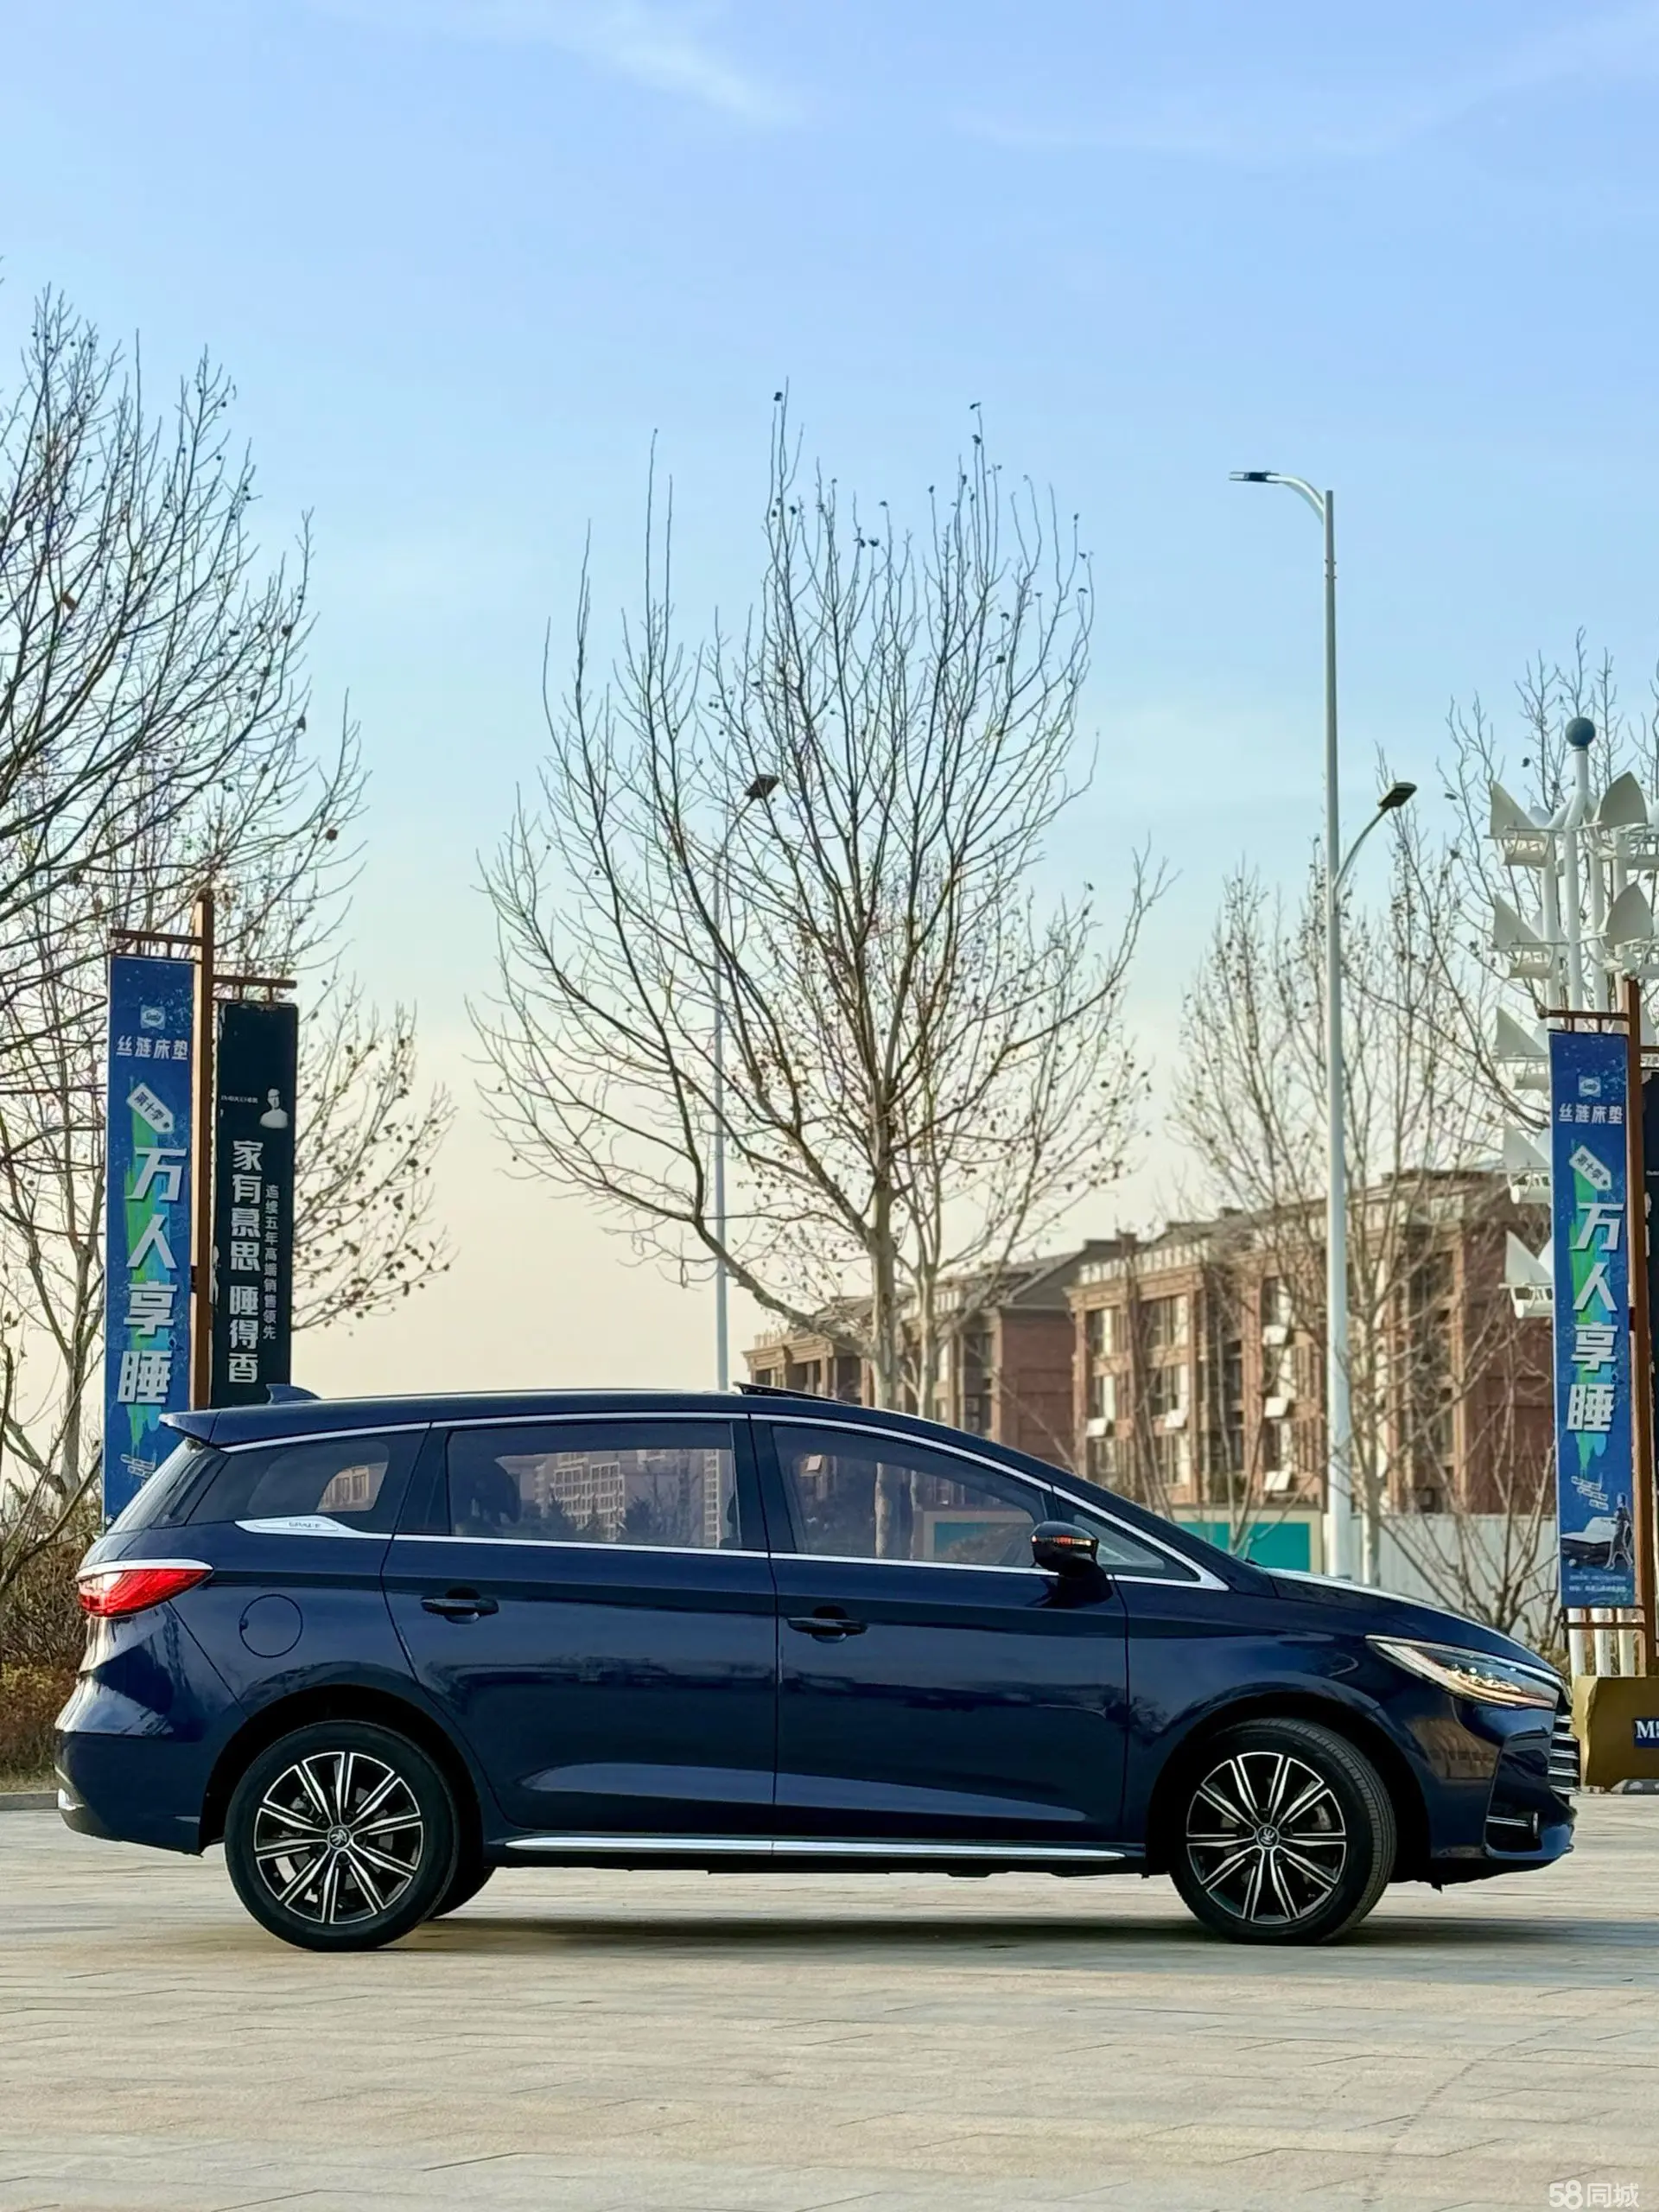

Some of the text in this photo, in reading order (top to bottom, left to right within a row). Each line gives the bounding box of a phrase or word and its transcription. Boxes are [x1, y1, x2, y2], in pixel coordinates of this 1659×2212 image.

[116, 1035, 188, 1060] 丝涟床垫
[1559, 1103, 1623, 1123] 丝涟床垫
[231, 1141, 264, 1271] 家有慕思
[118, 1147, 187, 1404] 万人享睡
[1567, 1202, 1624, 1431] 万人享睡
[229, 1286, 259, 1382] 睡得香
